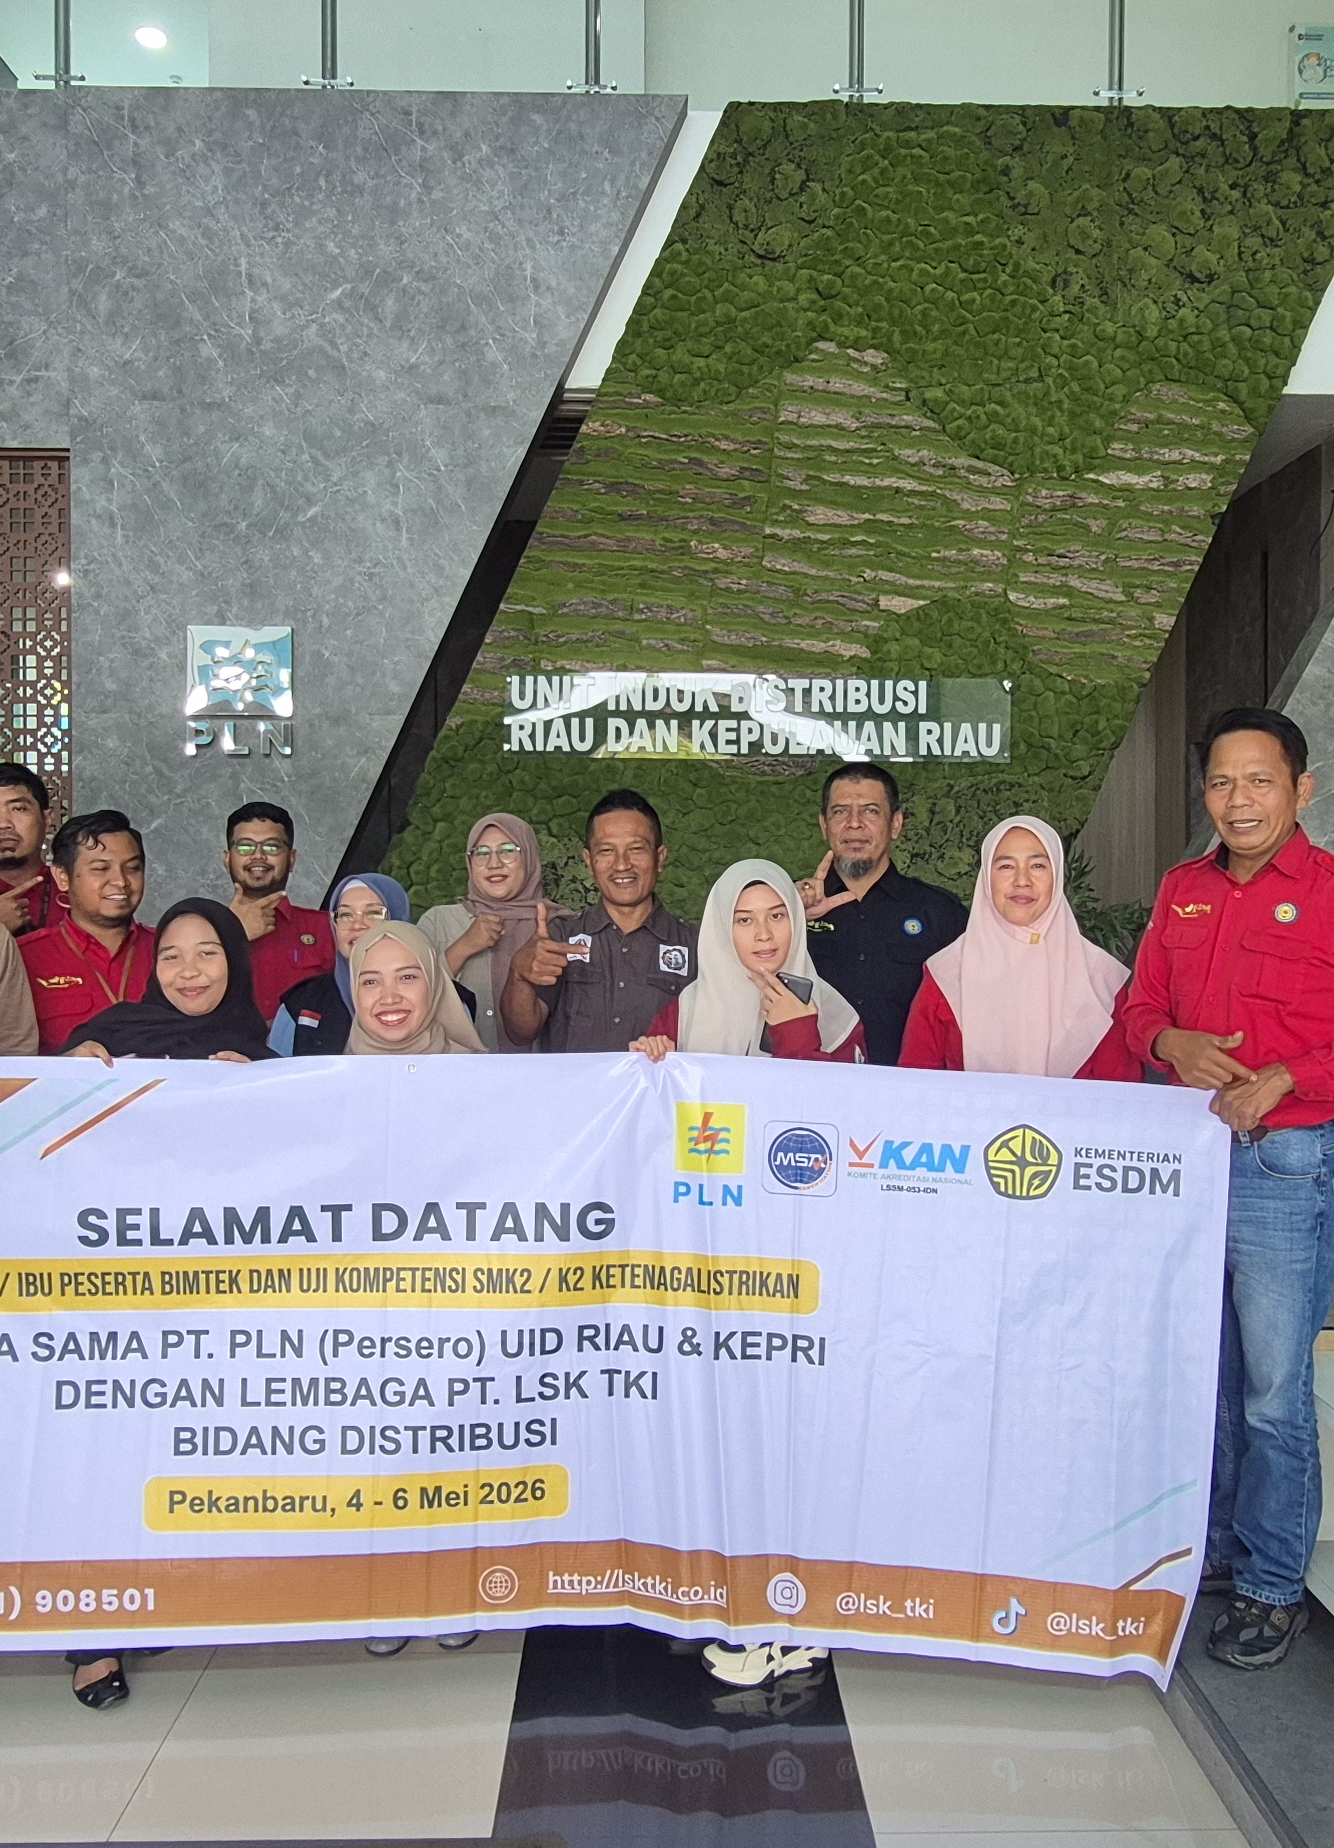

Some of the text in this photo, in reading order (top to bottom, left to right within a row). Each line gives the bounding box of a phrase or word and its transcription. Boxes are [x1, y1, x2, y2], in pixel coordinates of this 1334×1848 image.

[510, 674, 927, 714] UNIT INDUK DISTRIBUSI
[184, 721, 293, 757] PLN
[510, 717, 1001, 757] RIAU DAN KEPULAUAN RIAU
[878, 1139, 971, 1174] KAN
[1073, 1146, 1182, 1165] KEMENTERIAN
[673, 1181, 743, 1207] PLN
[847, 1171, 974, 1186] KOMITE AKREDITASI NASIONAL
[1072, 1162, 1181, 1198] ESDM
[76, 1201, 616, 1248] SELAMAT DATANG
[17, 1272, 53, 1297] IBU
[60, 1270, 155, 1297] PESERTA
[160, 1269, 242, 1296] BIMTEK
[248, 1268, 292, 1294] DAN
[299, 1267, 328, 1294] UJI
[335, 1266, 467, 1294] KOMPETENSI
[472, 1267, 532, 1295] SMK2
[538, 1267, 552, 1295] /
[558, 1266, 585, 1292] K2
[591, 1263, 800, 1300] KETENAGALISTRIKAN
[30, 1331, 149, 1363] SAMA
[161, 1330, 214, 1360] PT.
[229, 1329, 305, 1359] PLN
[318, 1328, 486, 1367] (Persero)
[500, 1327, 563, 1359] UID
[576, 1323, 665, 1354] RIAU
[677, 1326, 703, 1357] &
[712, 1331, 826, 1367] KEPRI
[54, 1368, 659, 1411] DENGAN LEMBAGA PT. LSK TKI
[172, 1418, 559, 1458] BIDANG DISTRIBUSI
[168, 1489, 337, 1518] Pekanbaru,
[346, 1488, 364, 1513] 4
[392, 1487, 409, 1512] 6
[420, 1484, 470, 1510] Mei
[478, 1479, 547, 1506] 2026
[35, 1587, 156, 1614] 908501
[548, 1568, 728, 1606] http://lsktki.co.id
[835, 1591, 935, 1620] @lsk_tki
[1046, 1611, 1146, 1641] @lsk_tki
